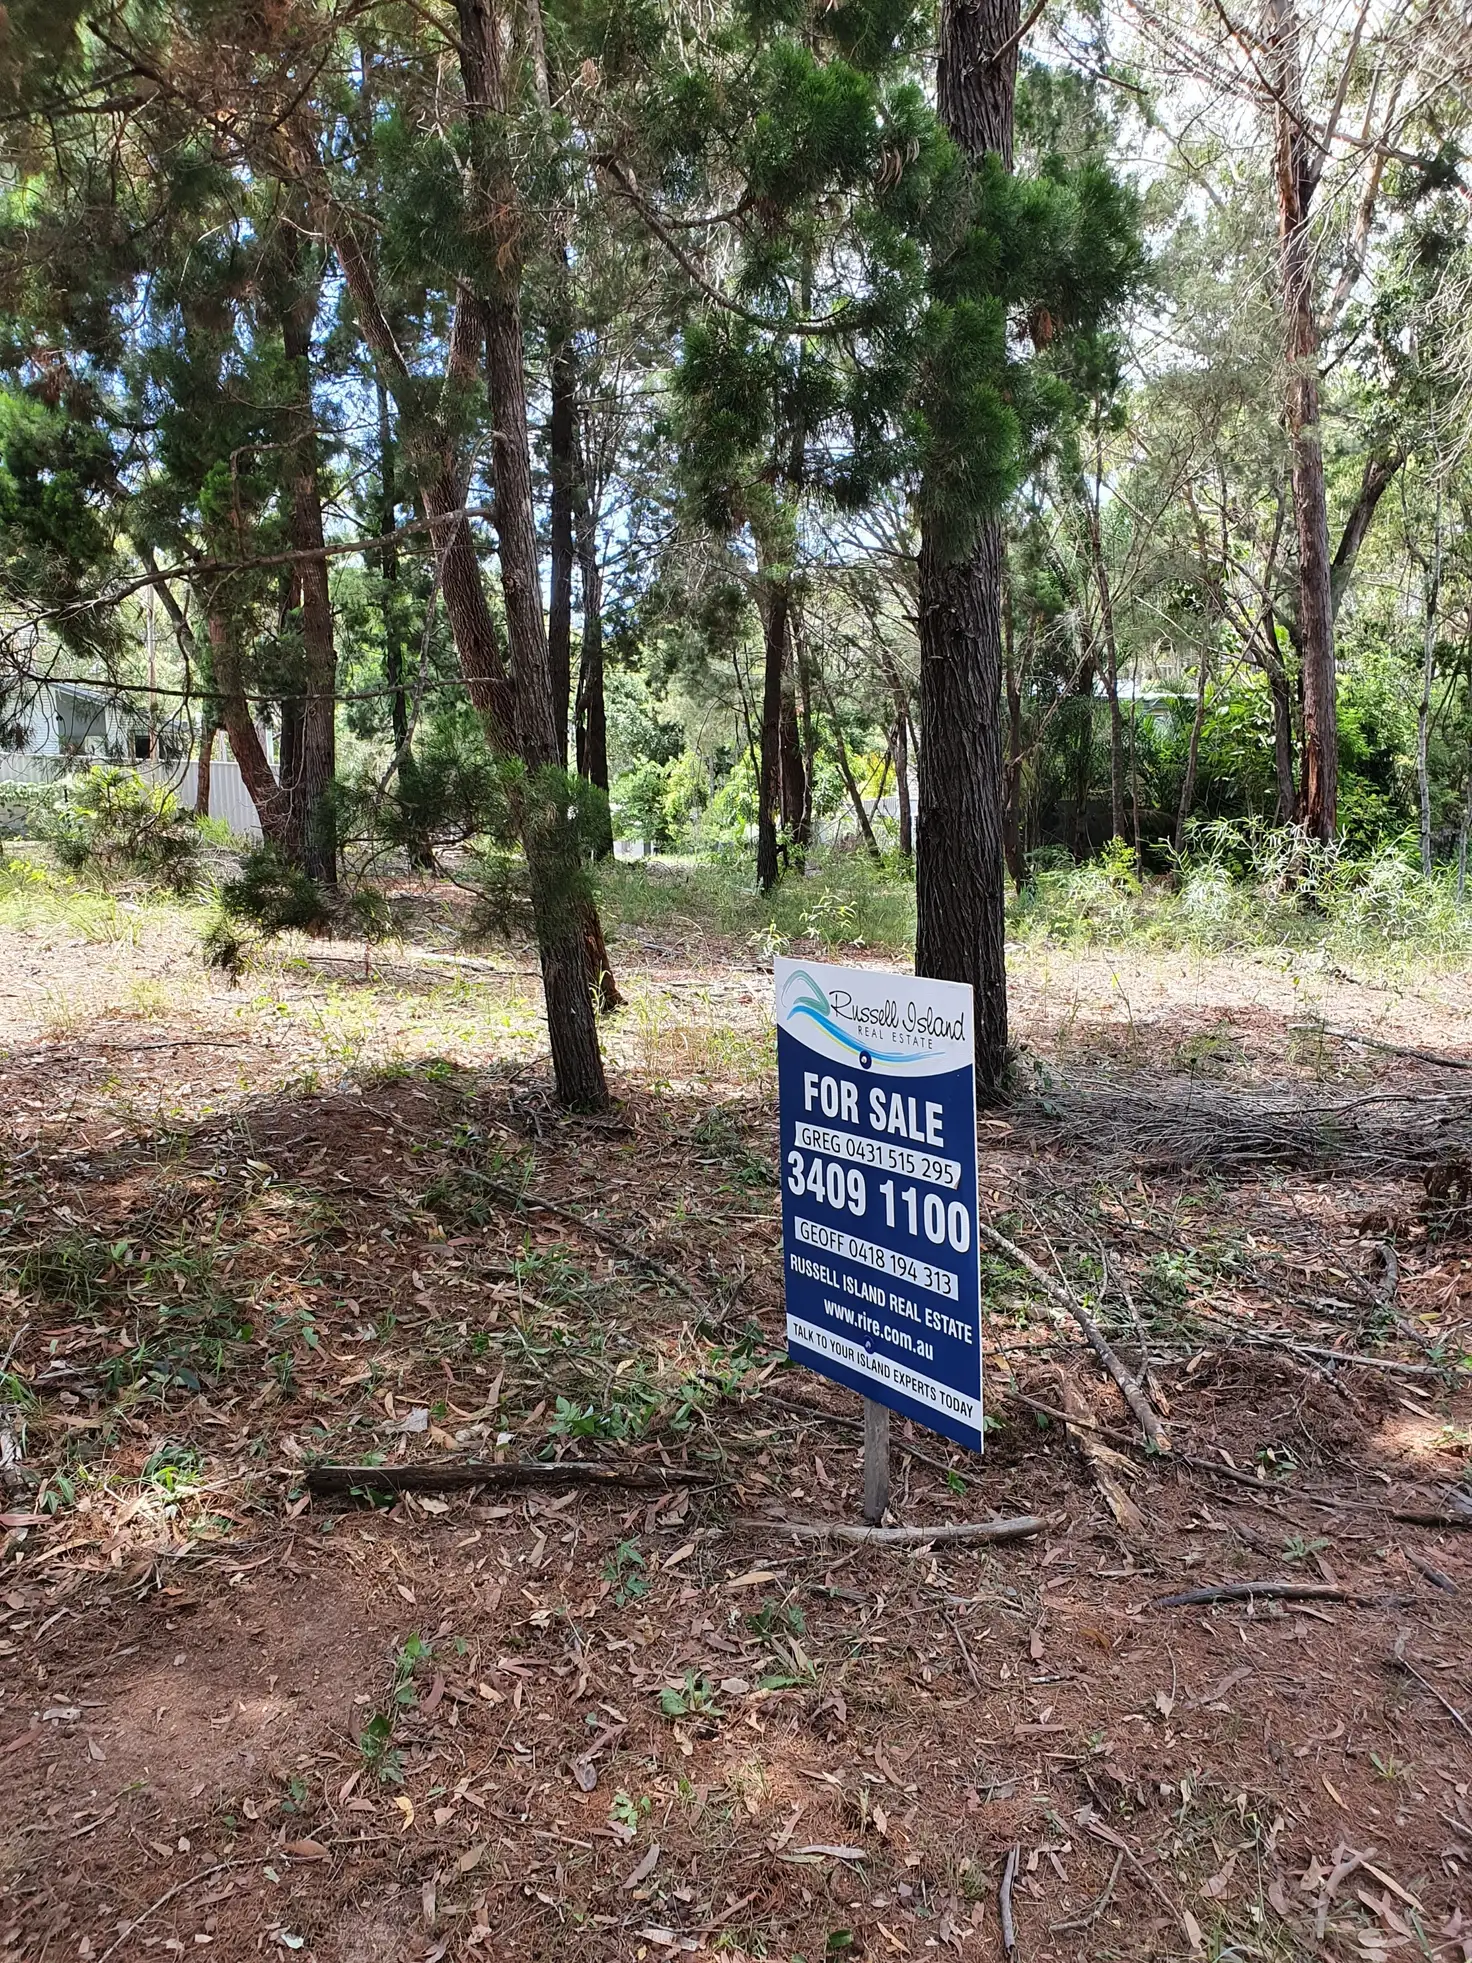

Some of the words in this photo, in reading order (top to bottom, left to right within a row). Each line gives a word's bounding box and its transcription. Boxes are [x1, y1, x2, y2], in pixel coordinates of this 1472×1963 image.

[829, 991, 899, 1028] Russell
[902, 1002, 966, 1041] Island
[858, 1025, 884, 1040] REAL
[892, 1032, 933, 1050] ESTATE
[804, 1071, 859, 1125] FOR
[869, 1088, 944, 1148] SALE
[802, 1127, 841, 1153] GREG
[846, 1138, 883, 1165] 0431
[889, 1150, 915, 1174] 515
[922, 1158, 954, 1184] 295
[787, 1150, 867, 1217] 3409
[880, 1179, 970, 1253] 1100
[800, 1221, 845, 1252] GEOFF
[849, 1239, 885, 1268] 0418
[890, 1254, 918, 1282] 194
[924, 1266, 952, 1295] 313
[790, 1253, 840, 1289] RUSSELL
[843, 1274, 886, 1307] ISLAND
[889, 1293, 922, 1324] REAL
[925, 1309, 973, 1345] ESTATE
[824, 1298, 934, 1361] www.rire.com.au
[793, 1322, 814, 1343] TALK
[816, 1332, 828, 1349] TO
[830, 1338, 855, 1363] YOUR
[857, 1352, 890, 1379] ISLAND
[893, 1370, 937, 1401] EXPERTS
[939, 1390, 973, 1419] TODAY
